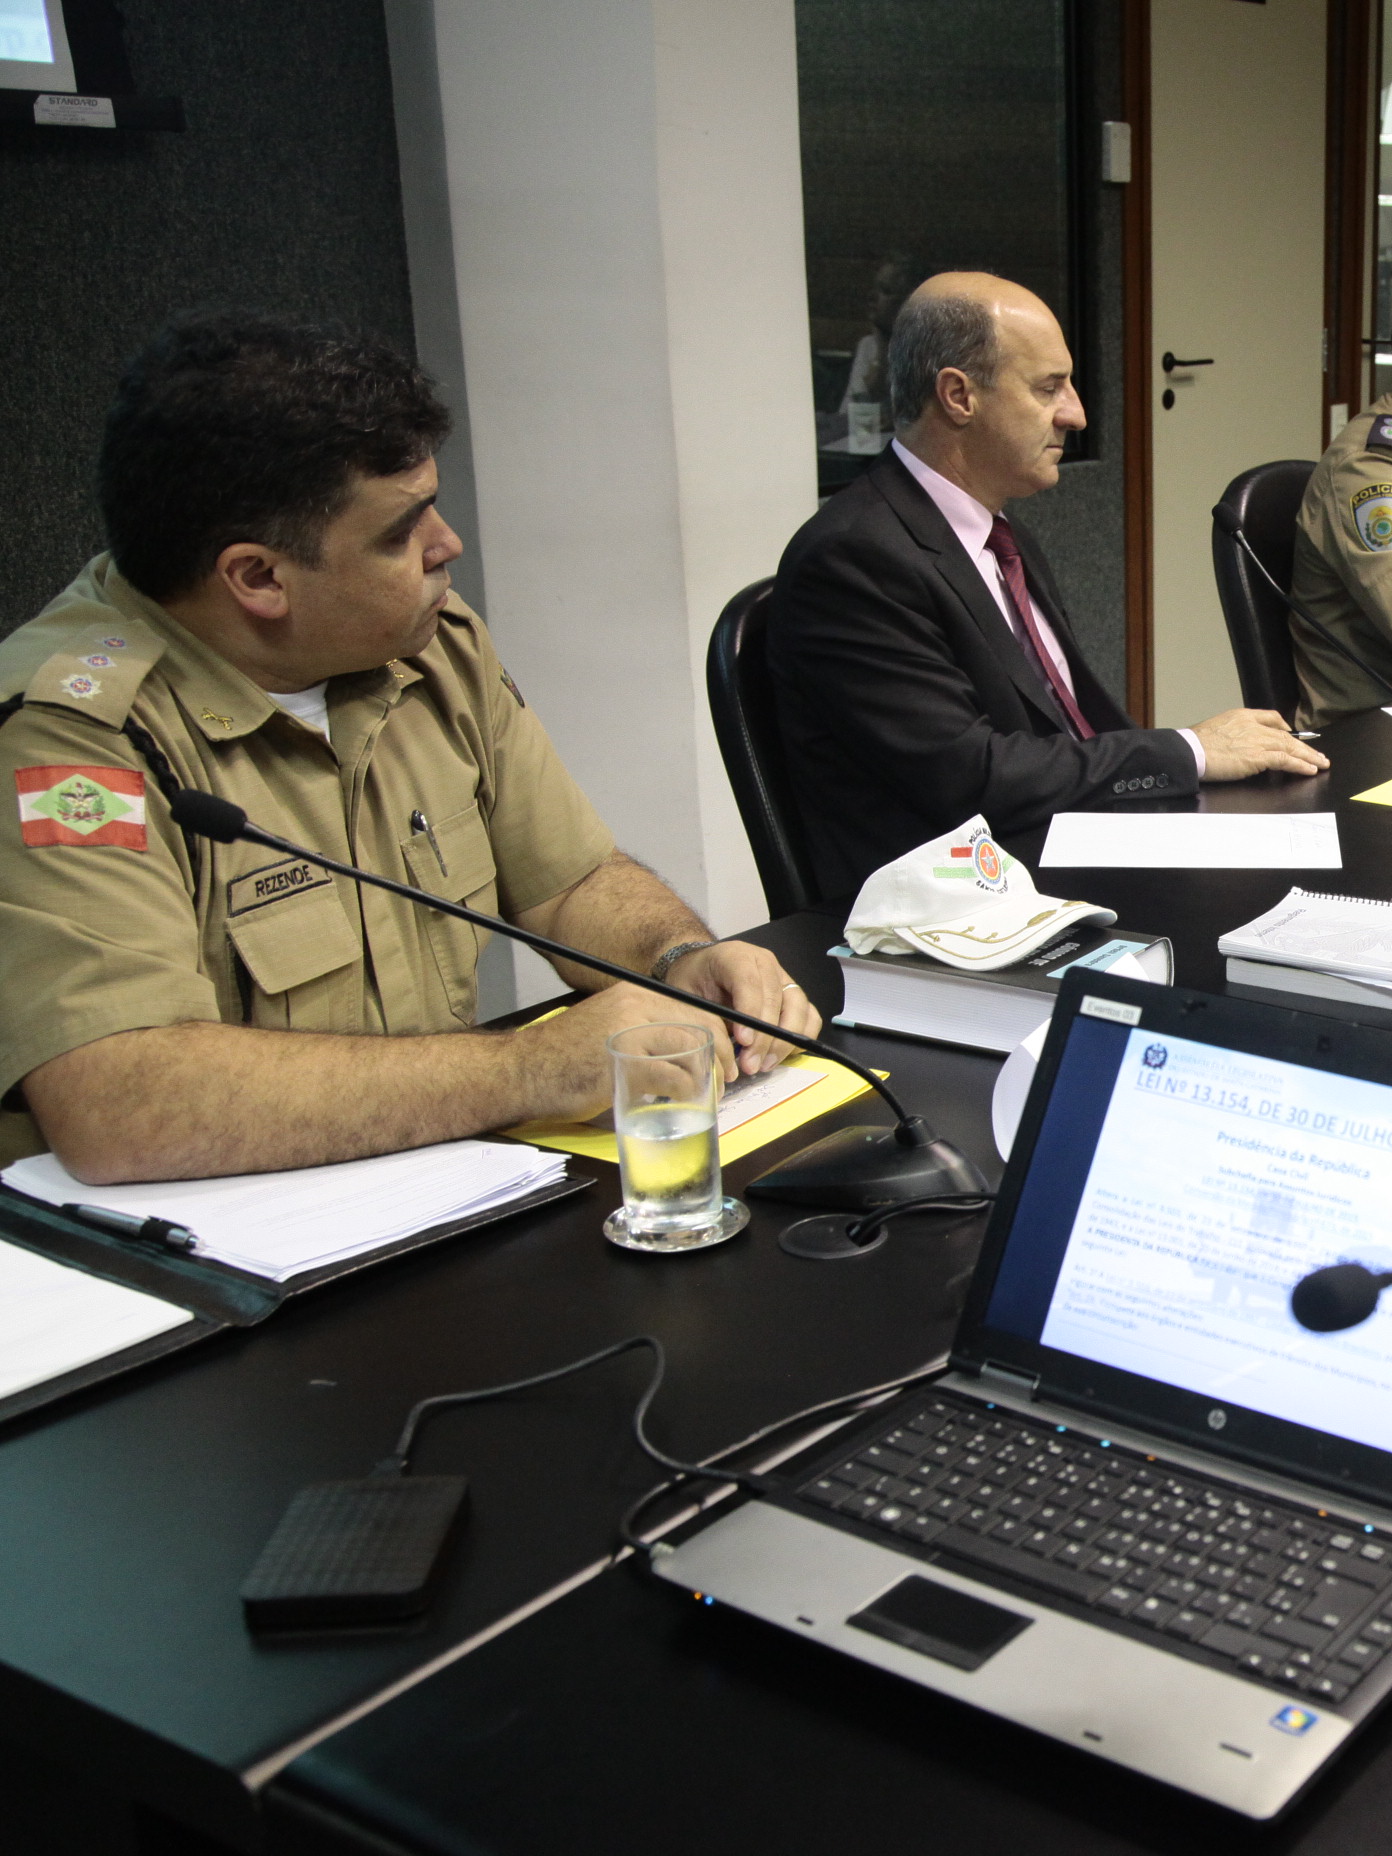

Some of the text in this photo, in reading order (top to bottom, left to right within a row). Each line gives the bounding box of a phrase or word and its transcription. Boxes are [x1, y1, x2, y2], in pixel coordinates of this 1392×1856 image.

[255, 864, 313, 897] REZENDE
[1135, 1069, 1162, 1090] LEI
[1190, 1083, 1255, 1116] 13.154,
[1257, 1099, 1283, 1120] DE
[1285, 1105, 1310, 1126] 30
[1311, 1112, 1338, 1133] DE
